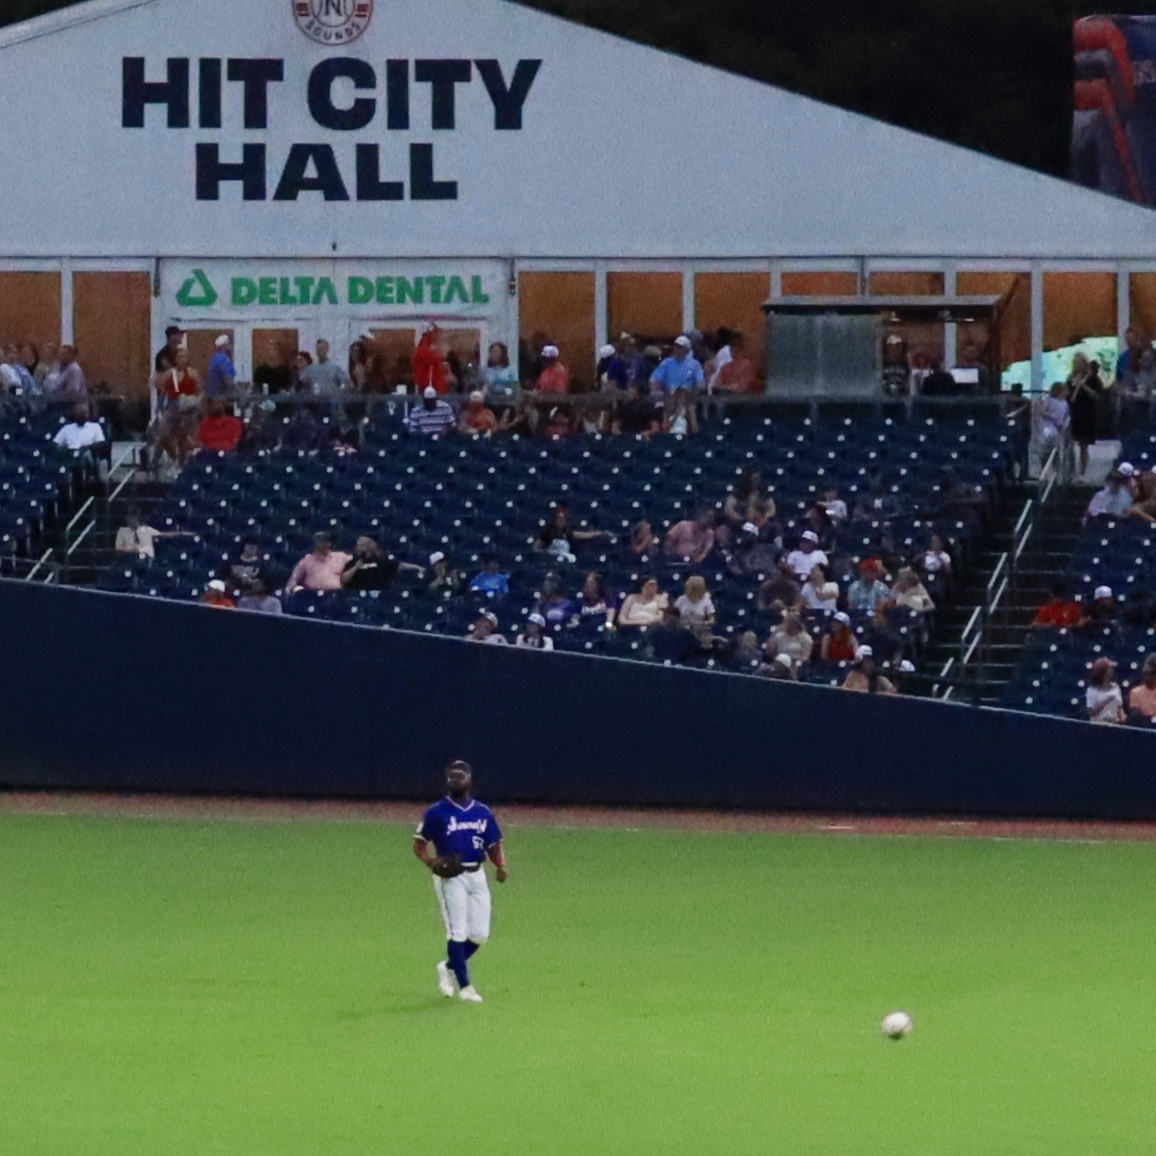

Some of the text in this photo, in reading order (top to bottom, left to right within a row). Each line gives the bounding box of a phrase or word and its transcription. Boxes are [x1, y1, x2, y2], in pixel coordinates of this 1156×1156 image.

[121, 56, 543, 131] HIT CITY
[195, 143, 458, 202] HALL
[230, 275, 491, 306] DELTA DENTAL
